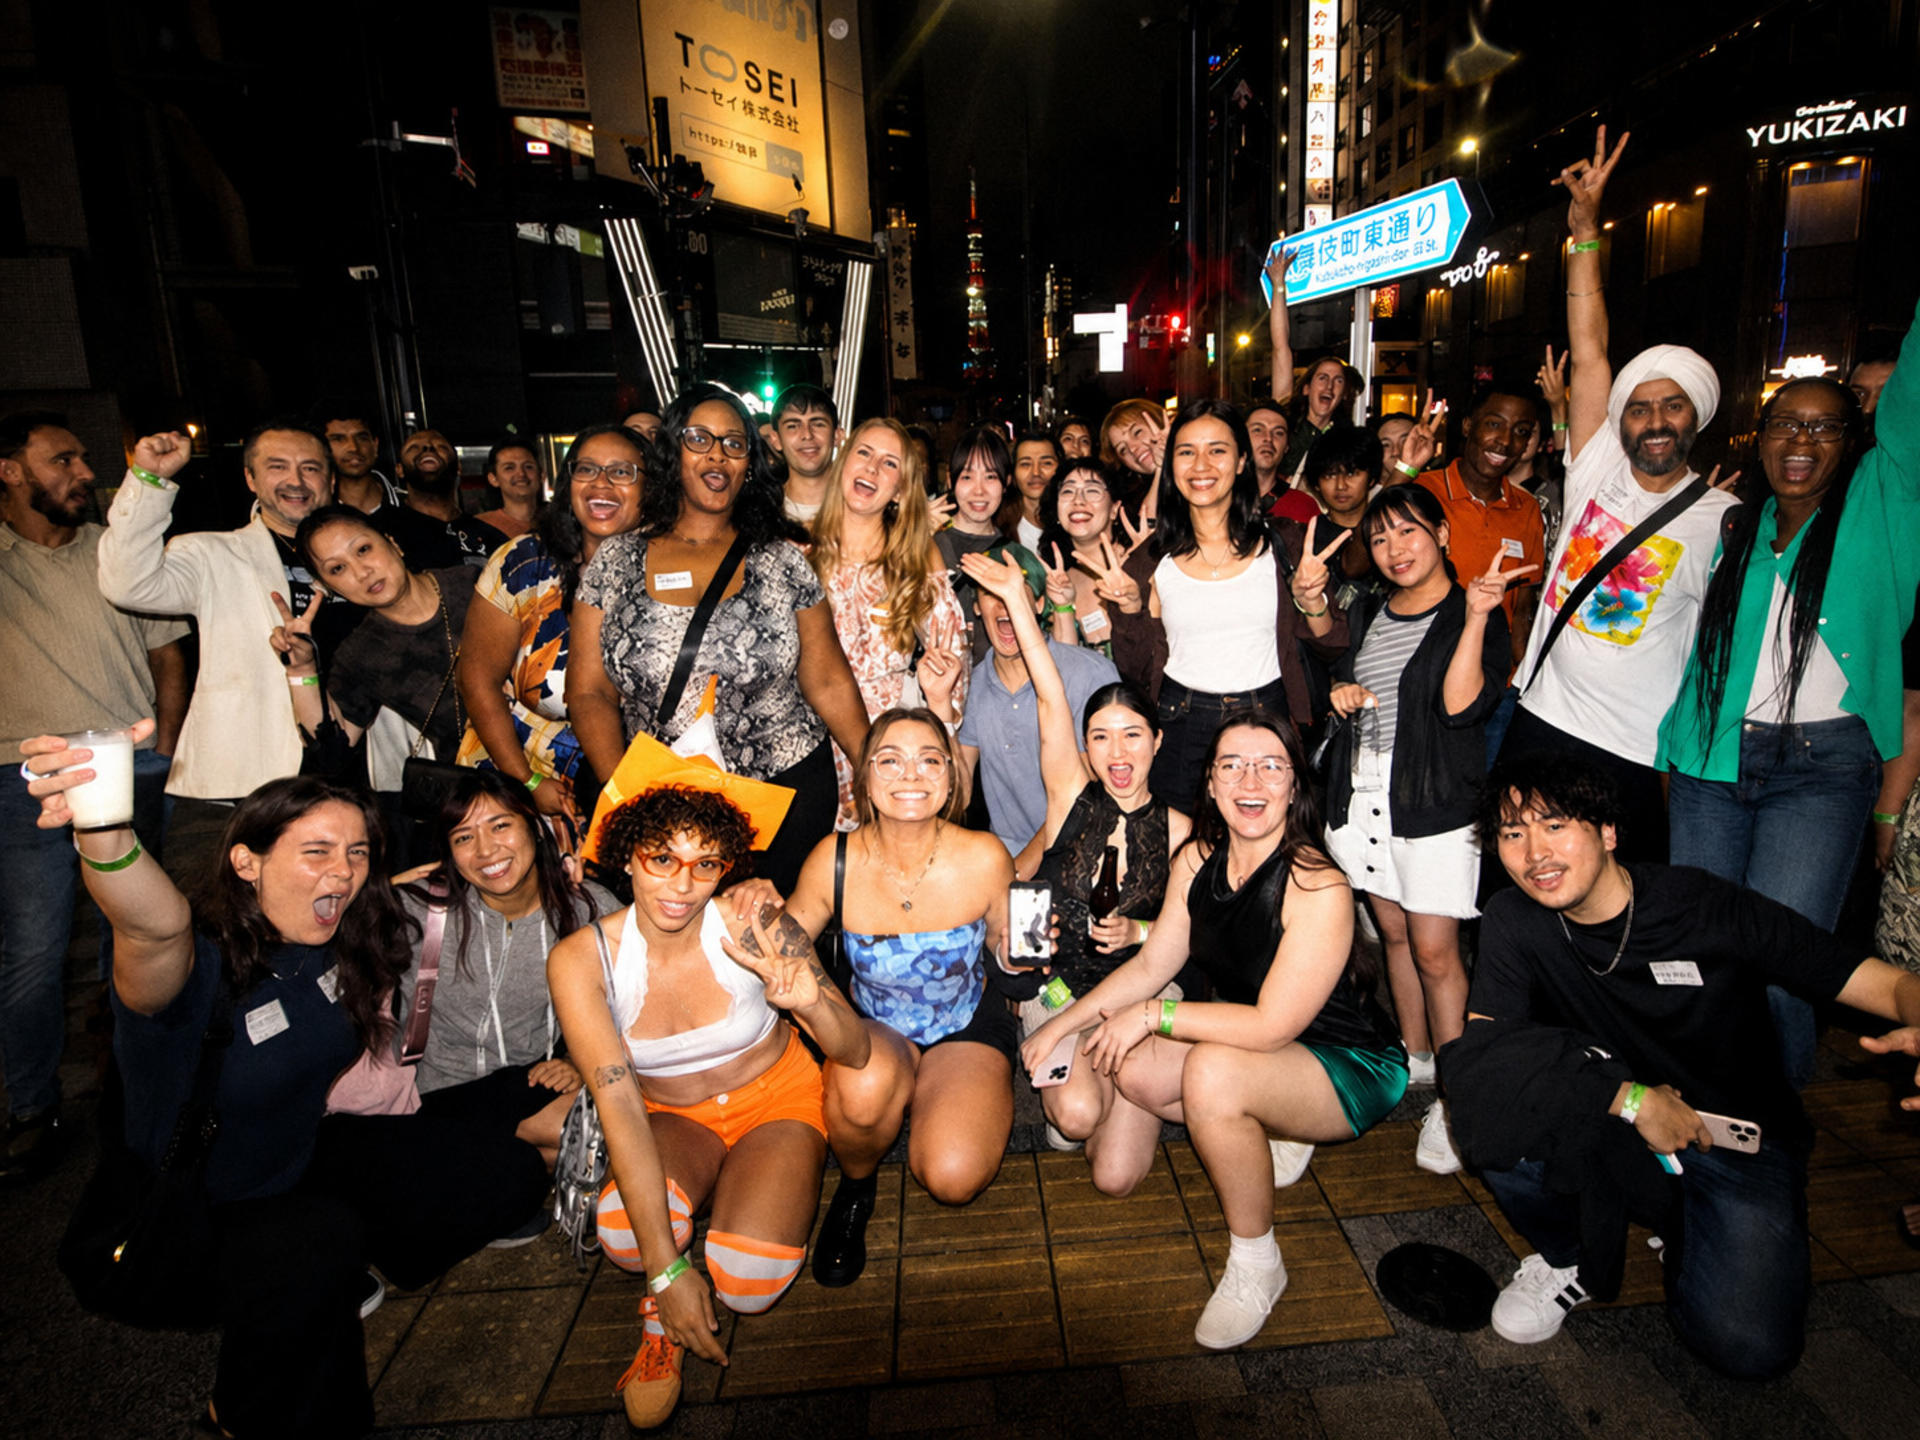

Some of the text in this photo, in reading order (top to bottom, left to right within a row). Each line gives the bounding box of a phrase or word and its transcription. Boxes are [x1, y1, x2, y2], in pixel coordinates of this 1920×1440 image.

[679, 75, 801, 135] トーセイ株式会社
[1746, 105, 1908, 148] YUKIZAKI
[1283, 202, 1437, 272] 舞伎町東通り
